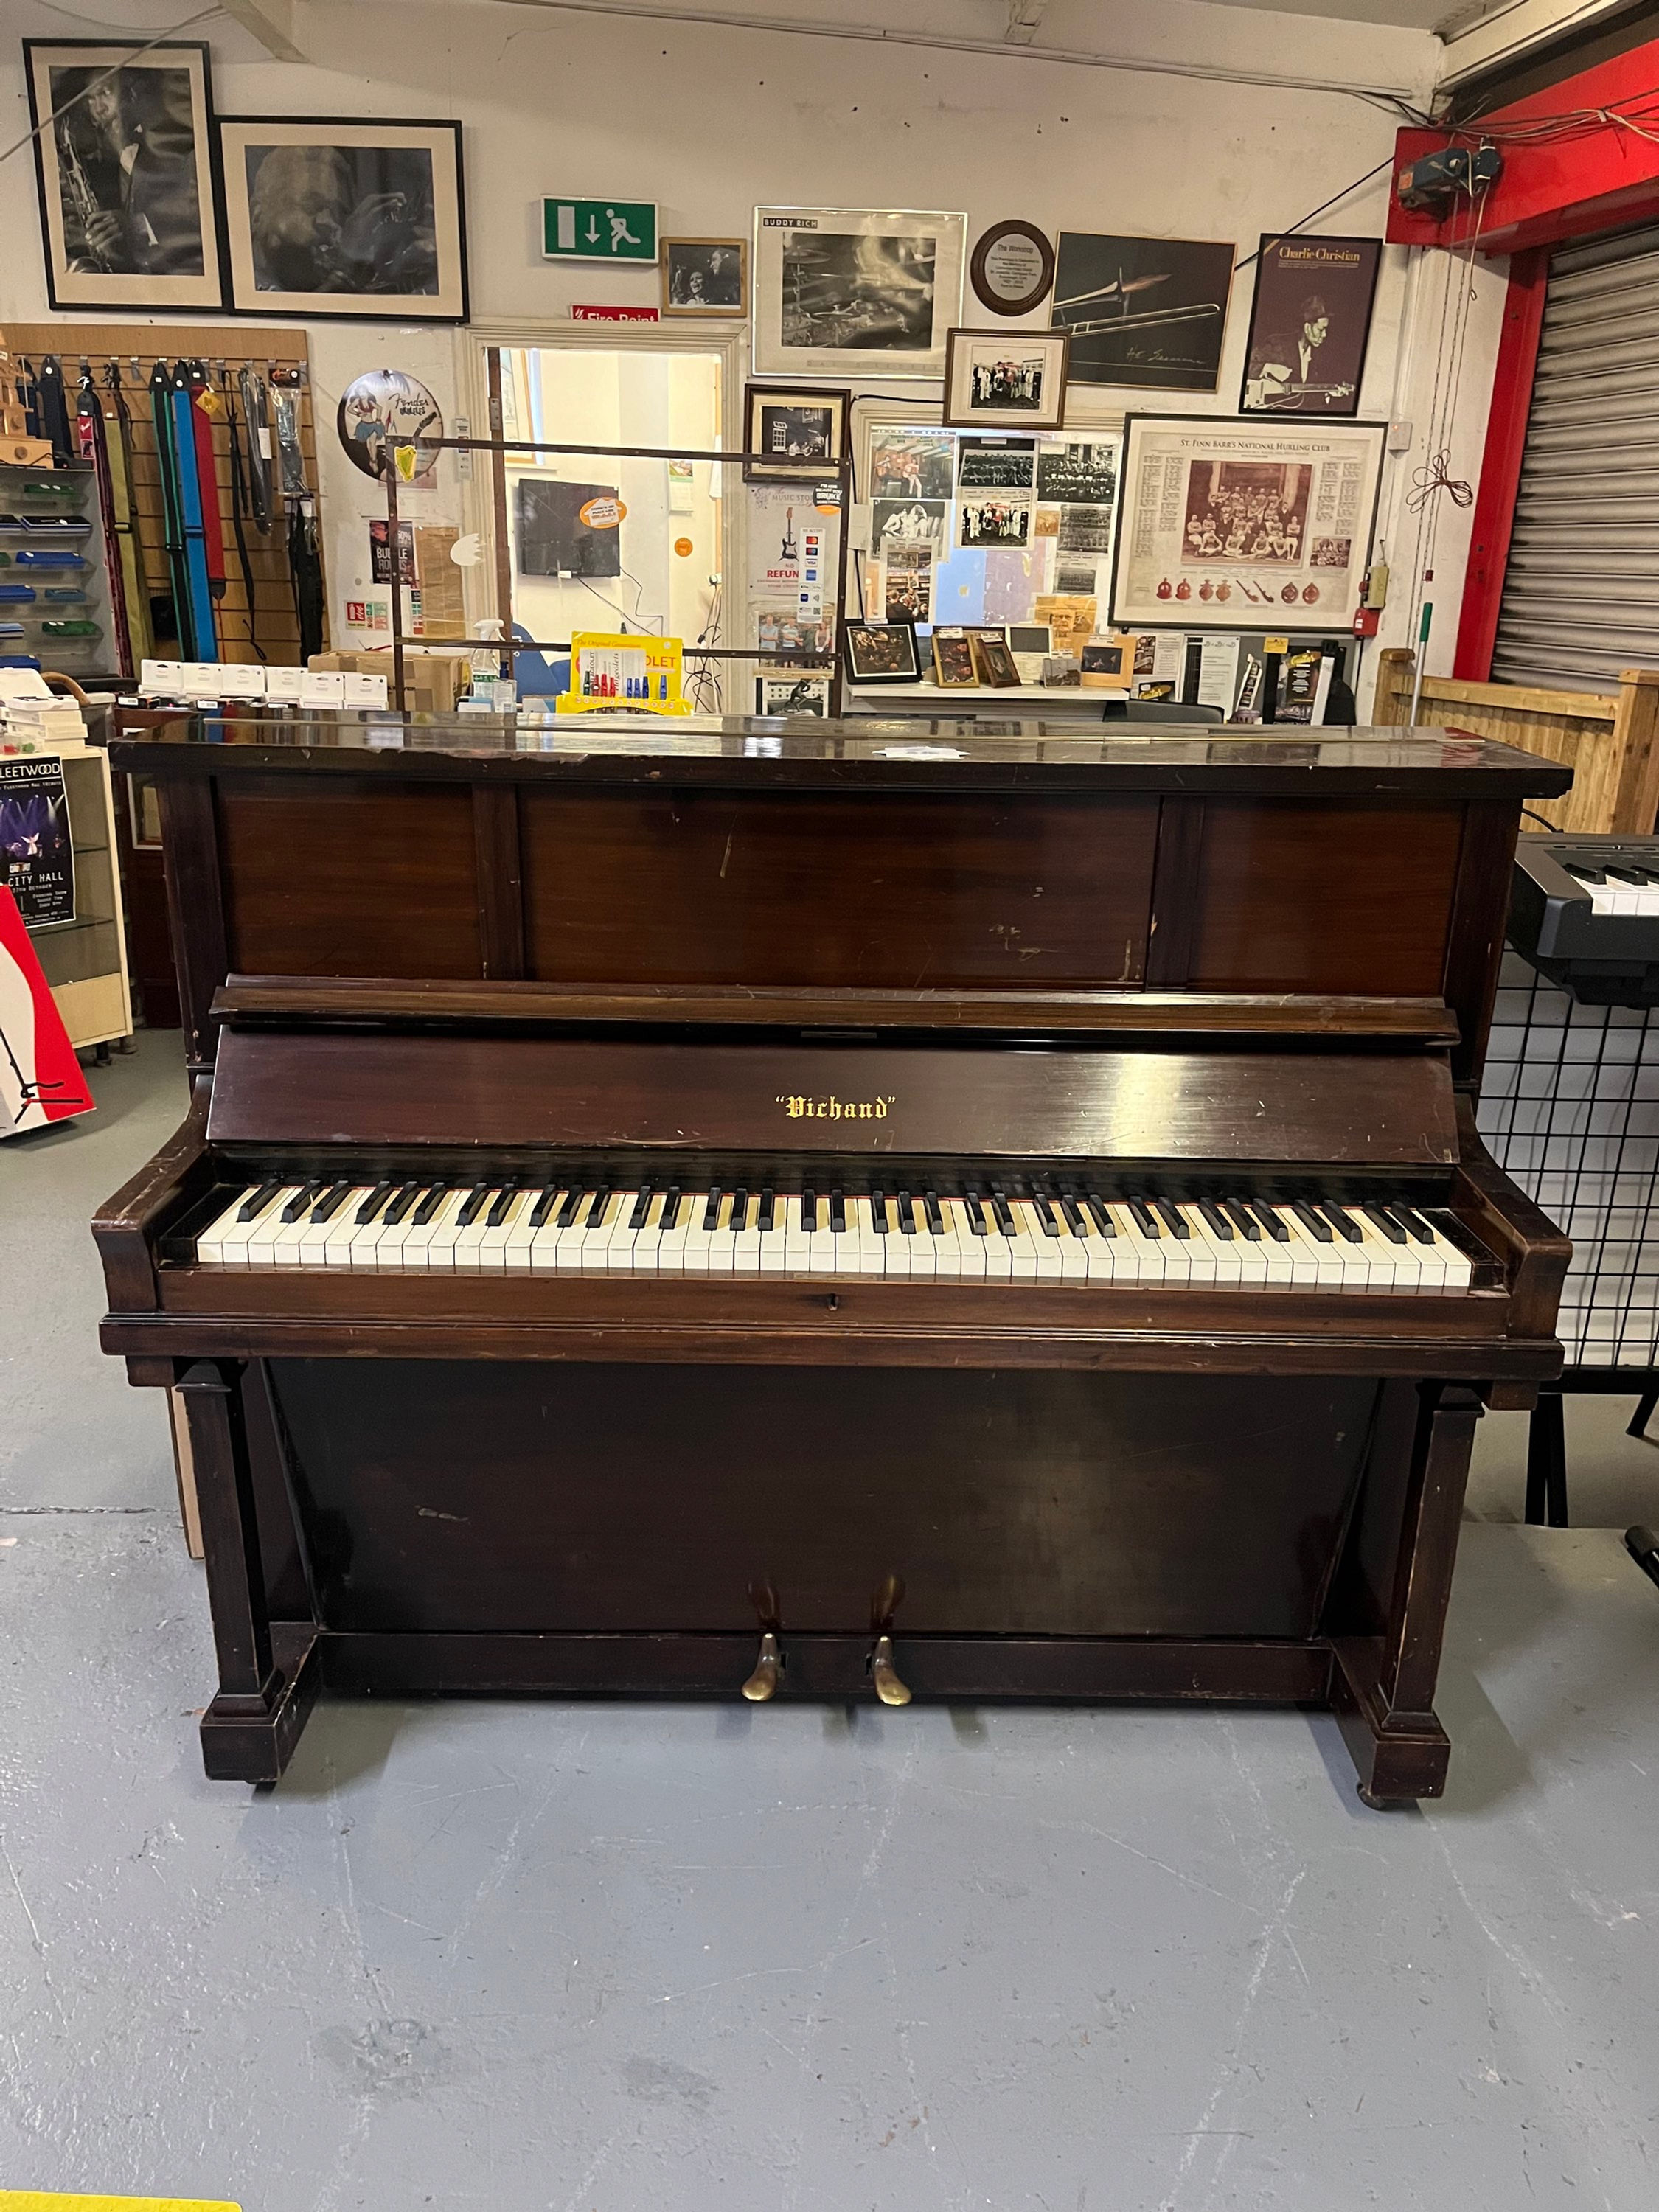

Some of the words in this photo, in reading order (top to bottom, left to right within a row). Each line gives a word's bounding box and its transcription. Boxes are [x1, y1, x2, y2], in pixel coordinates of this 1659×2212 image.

[764, 219, 793, 227] BUDDY
[1279, 246, 1315, 259] Charlie
[1315, 248, 1360, 261] Christian
[588, 313, 613, 321] Fire
[619, 314, 655, 322] Point
[389, 393, 429, 409] Fender
[1238, 442, 1274, 451] NATIONAL
[1312, 444, 1330, 452] CLUB
[377, 547, 408, 560] BULE
[767, 570, 799, 578] REFUN
[0, 763, 60, 778] LEETWOOD
[8, 875, 32, 887] CITY
[39, 872, 63, 883] HALL
